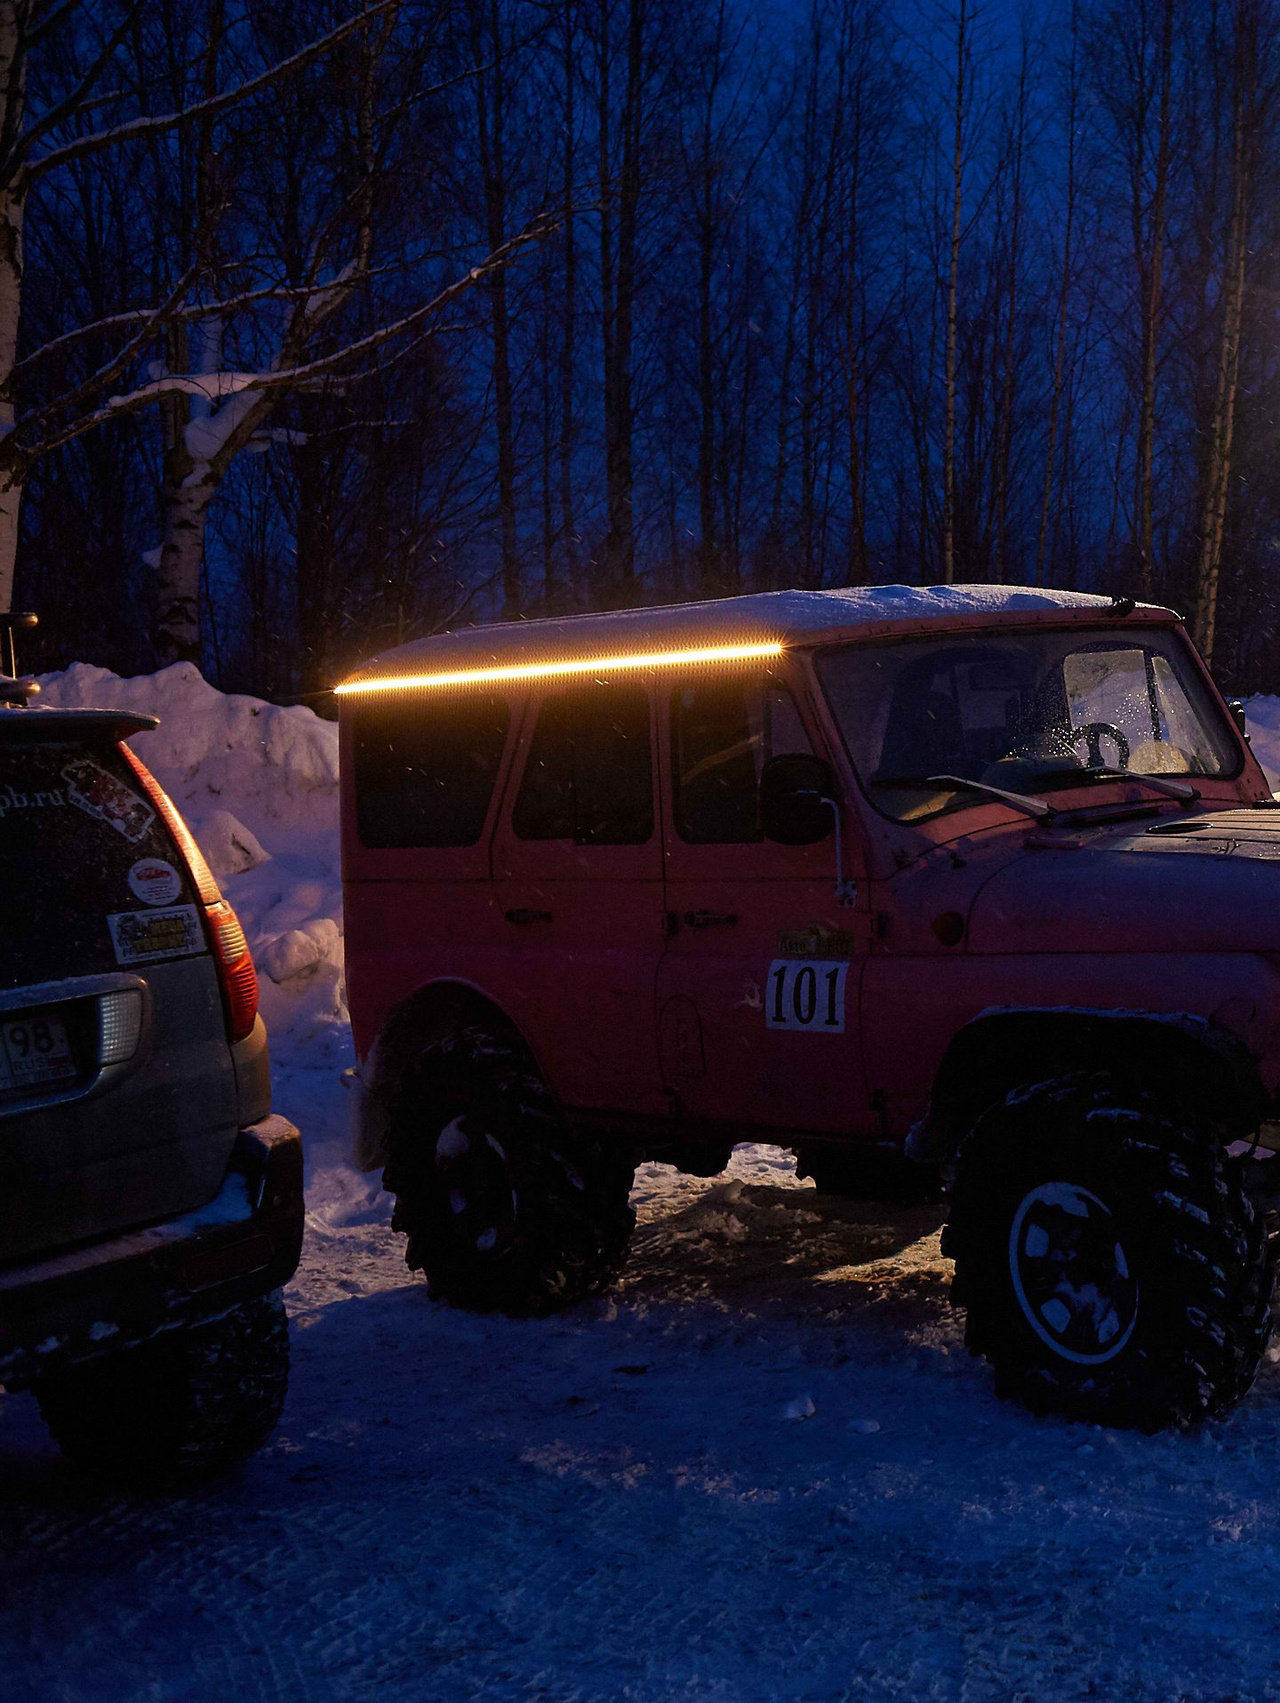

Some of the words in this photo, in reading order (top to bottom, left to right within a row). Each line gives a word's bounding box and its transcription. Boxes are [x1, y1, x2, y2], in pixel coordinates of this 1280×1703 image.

[772, 966, 839, 1026] 101
[10, 1023, 54, 1057] 98
[13, 1057, 46, 1072] RUS
